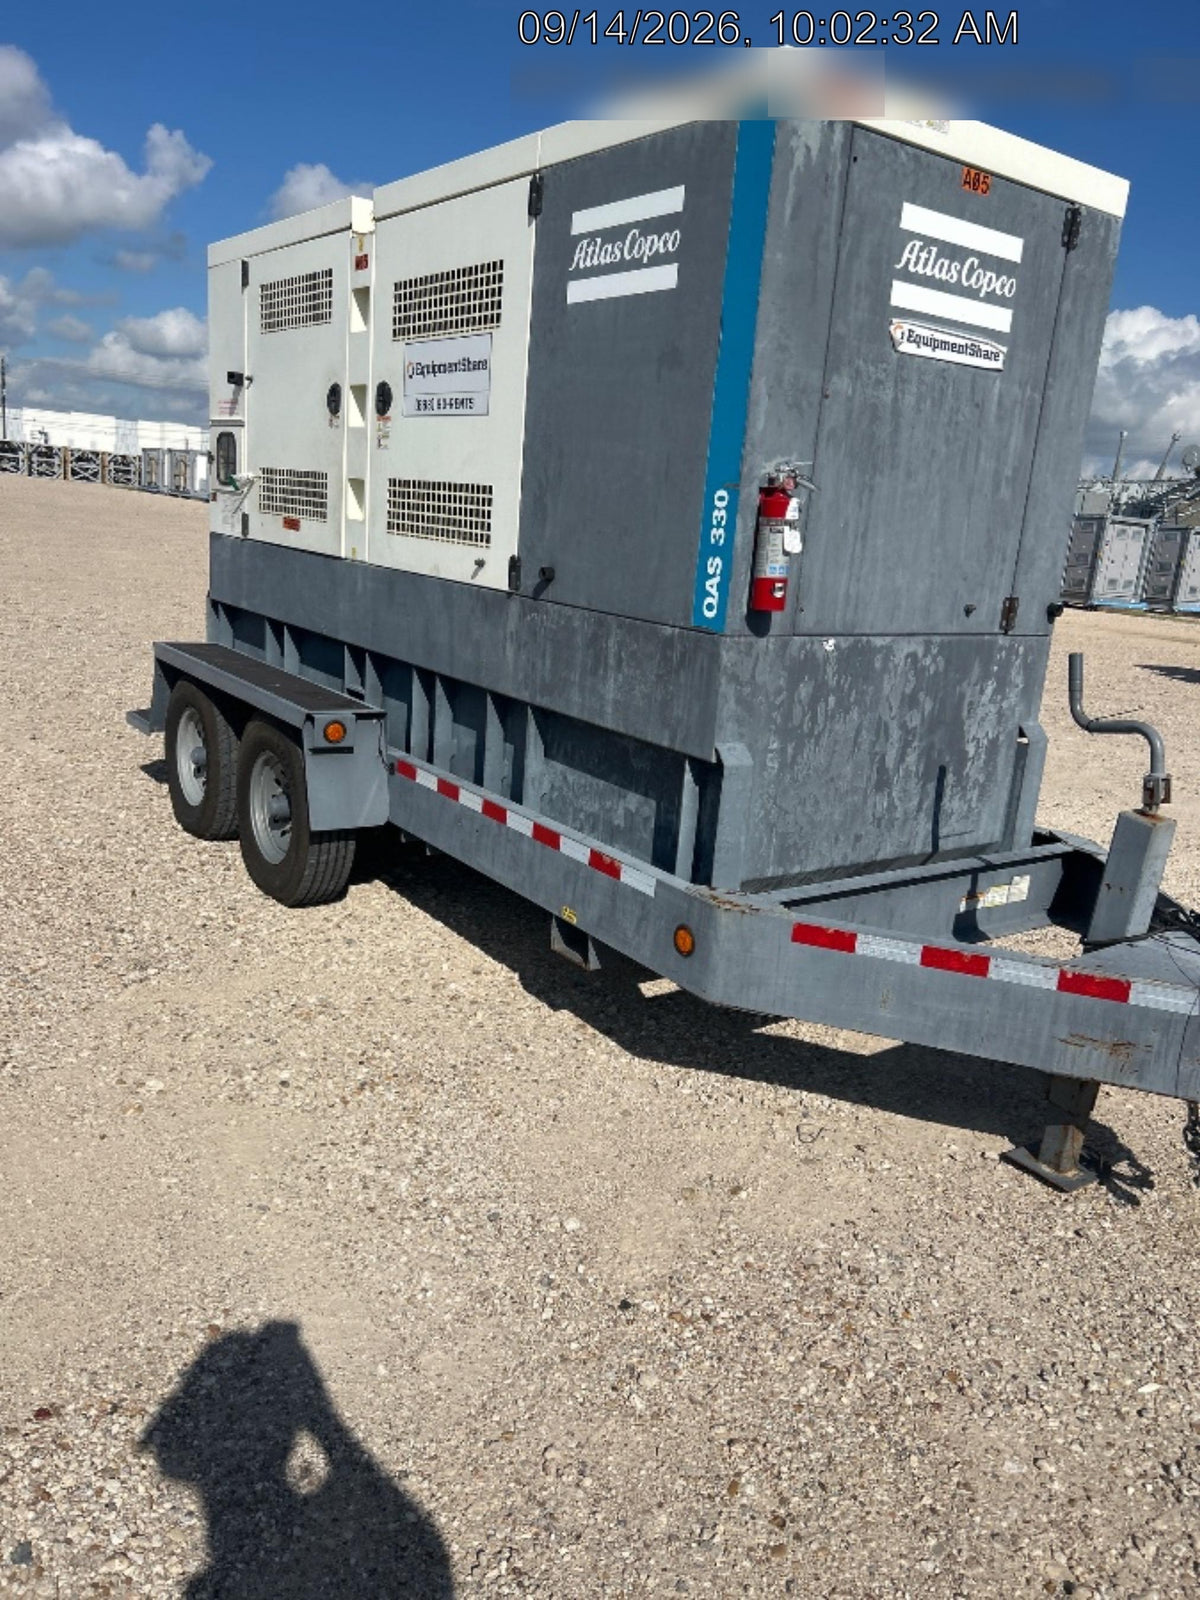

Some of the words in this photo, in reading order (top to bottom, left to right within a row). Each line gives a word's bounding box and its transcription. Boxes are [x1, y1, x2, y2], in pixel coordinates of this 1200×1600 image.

[568, 237, 623, 271] Atlas
[623, 228, 681, 264] Copco
[894, 239, 960, 284] Atlas
[961, 256, 1017, 298] Copco
[906, 328, 1001, 362] EquipmentShare
[415, 357, 488, 379] EquipmentShare
[710, 488, 730, 547] 330
